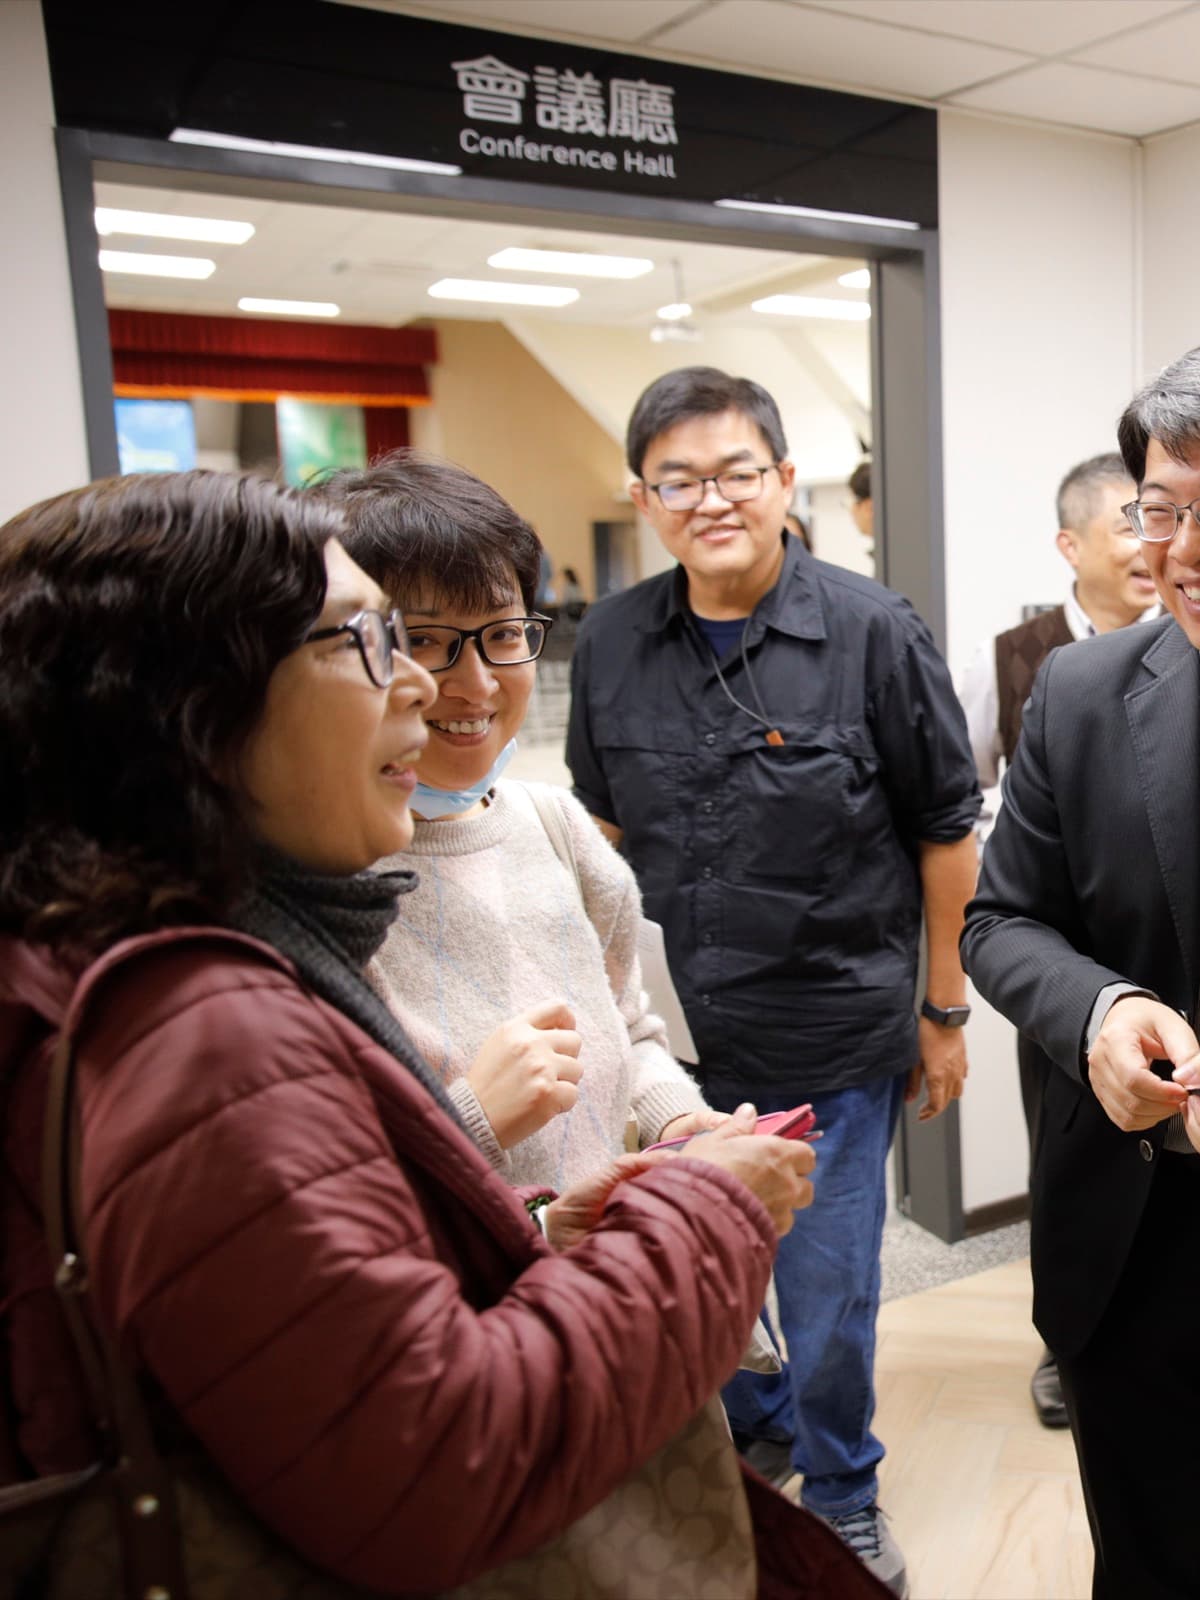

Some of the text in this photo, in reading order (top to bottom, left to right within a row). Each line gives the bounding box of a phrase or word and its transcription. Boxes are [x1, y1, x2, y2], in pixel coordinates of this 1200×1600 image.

[451, 54, 679, 145] 會議廳
[459, 128, 677, 178] Conference Hall
